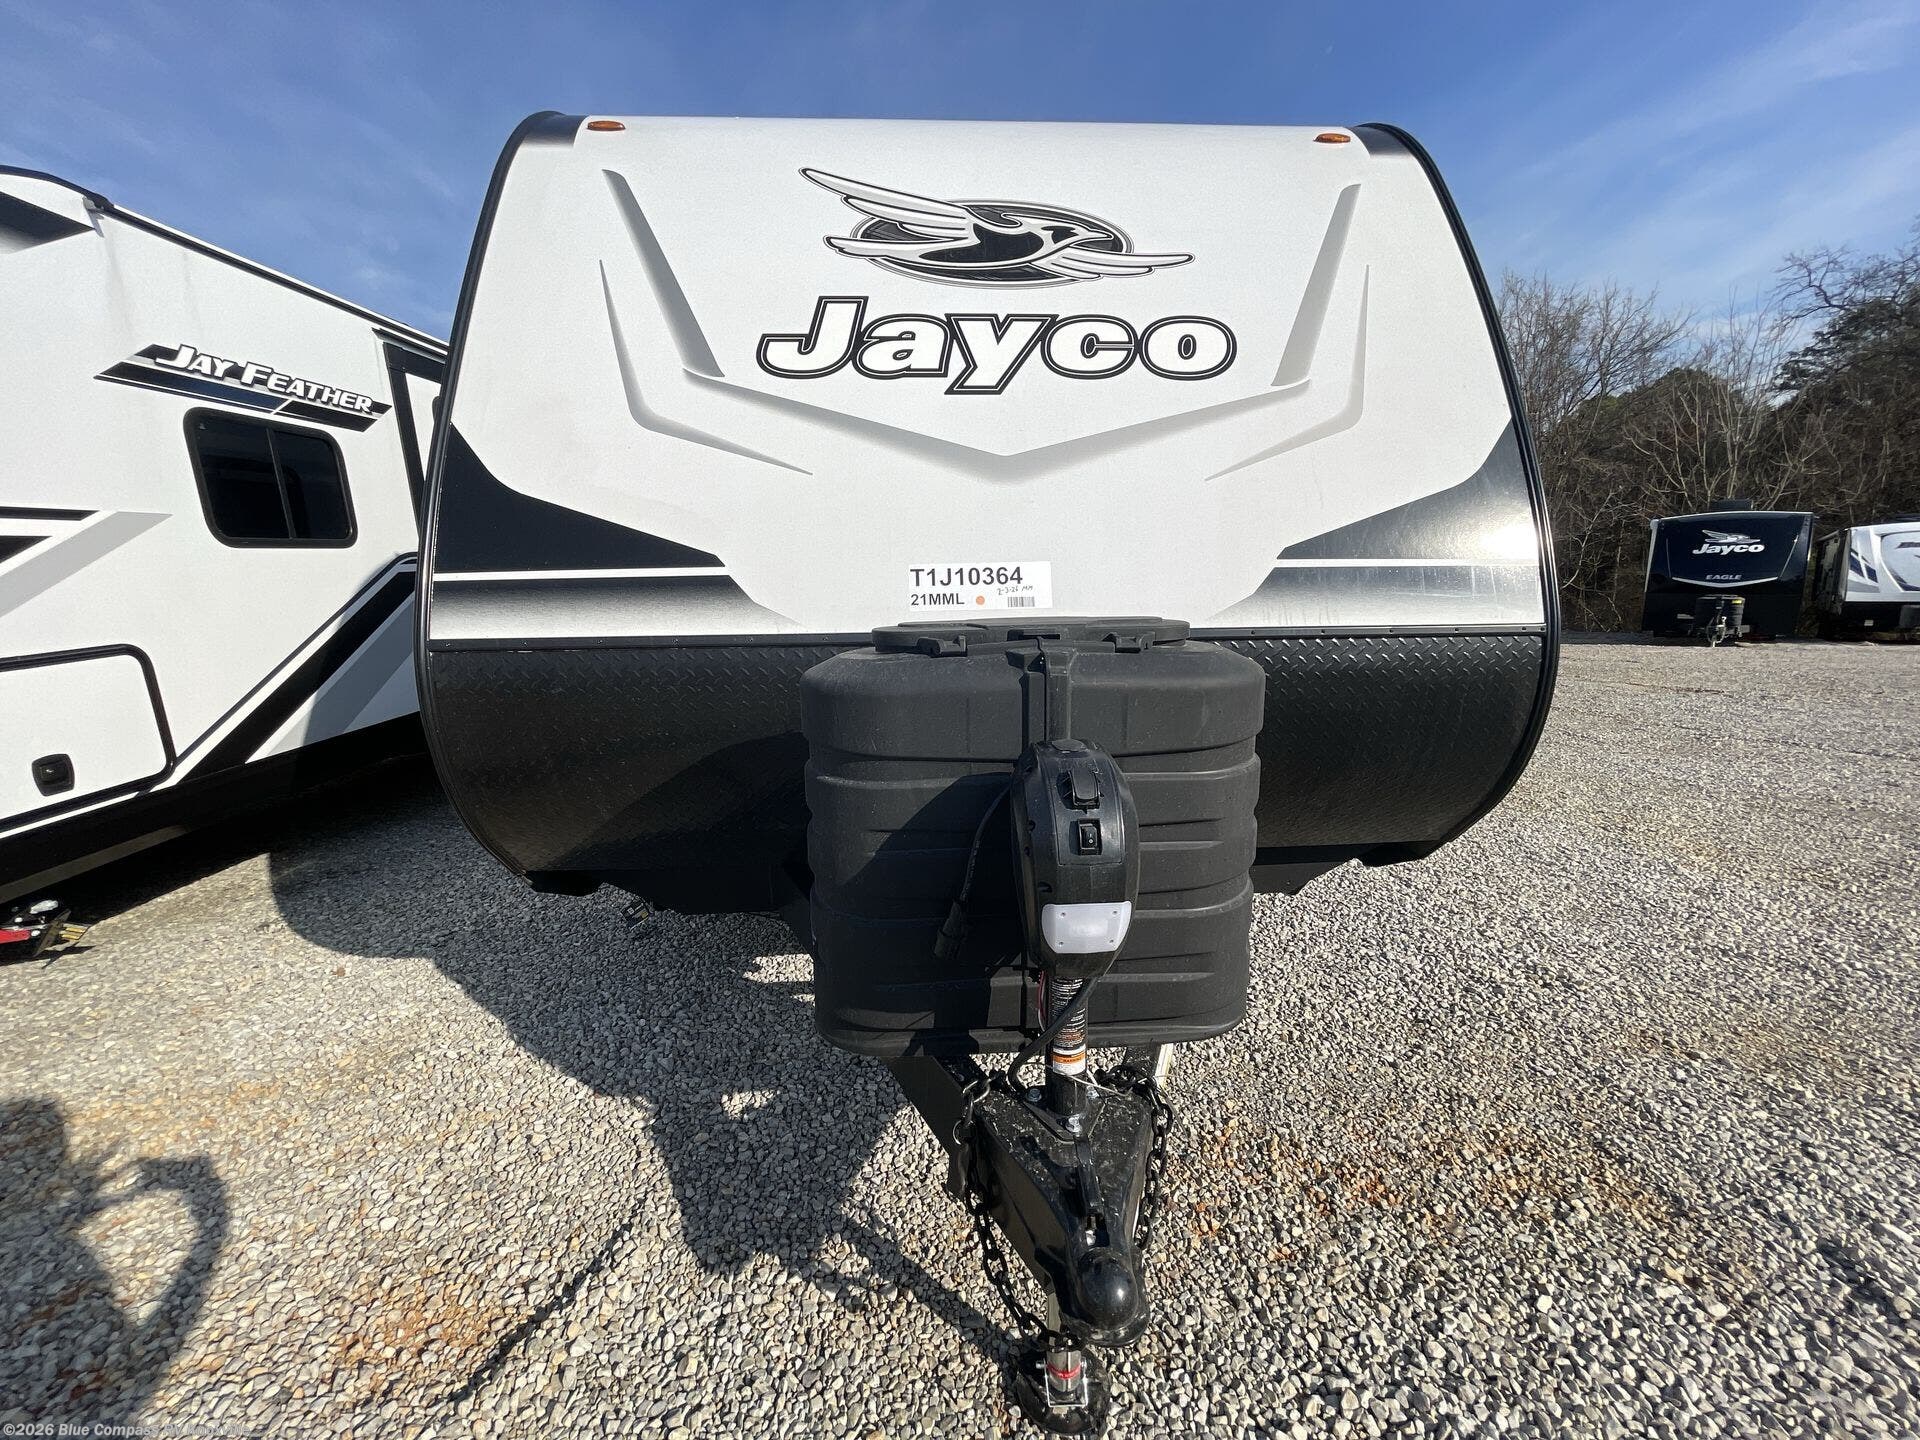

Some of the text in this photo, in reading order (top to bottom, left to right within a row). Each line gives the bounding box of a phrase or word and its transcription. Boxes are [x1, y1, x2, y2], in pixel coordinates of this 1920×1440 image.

[756, 295, 1237, 395] Jayco
[155, 344, 375, 413] JAY FEATHER
[1692, 543, 1765, 555] Jayco
[910, 567, 1022, 586] T1J10364
[1706, 573, 1742, 581] EAGLE
[910, 593, 965, 606] 21MML
